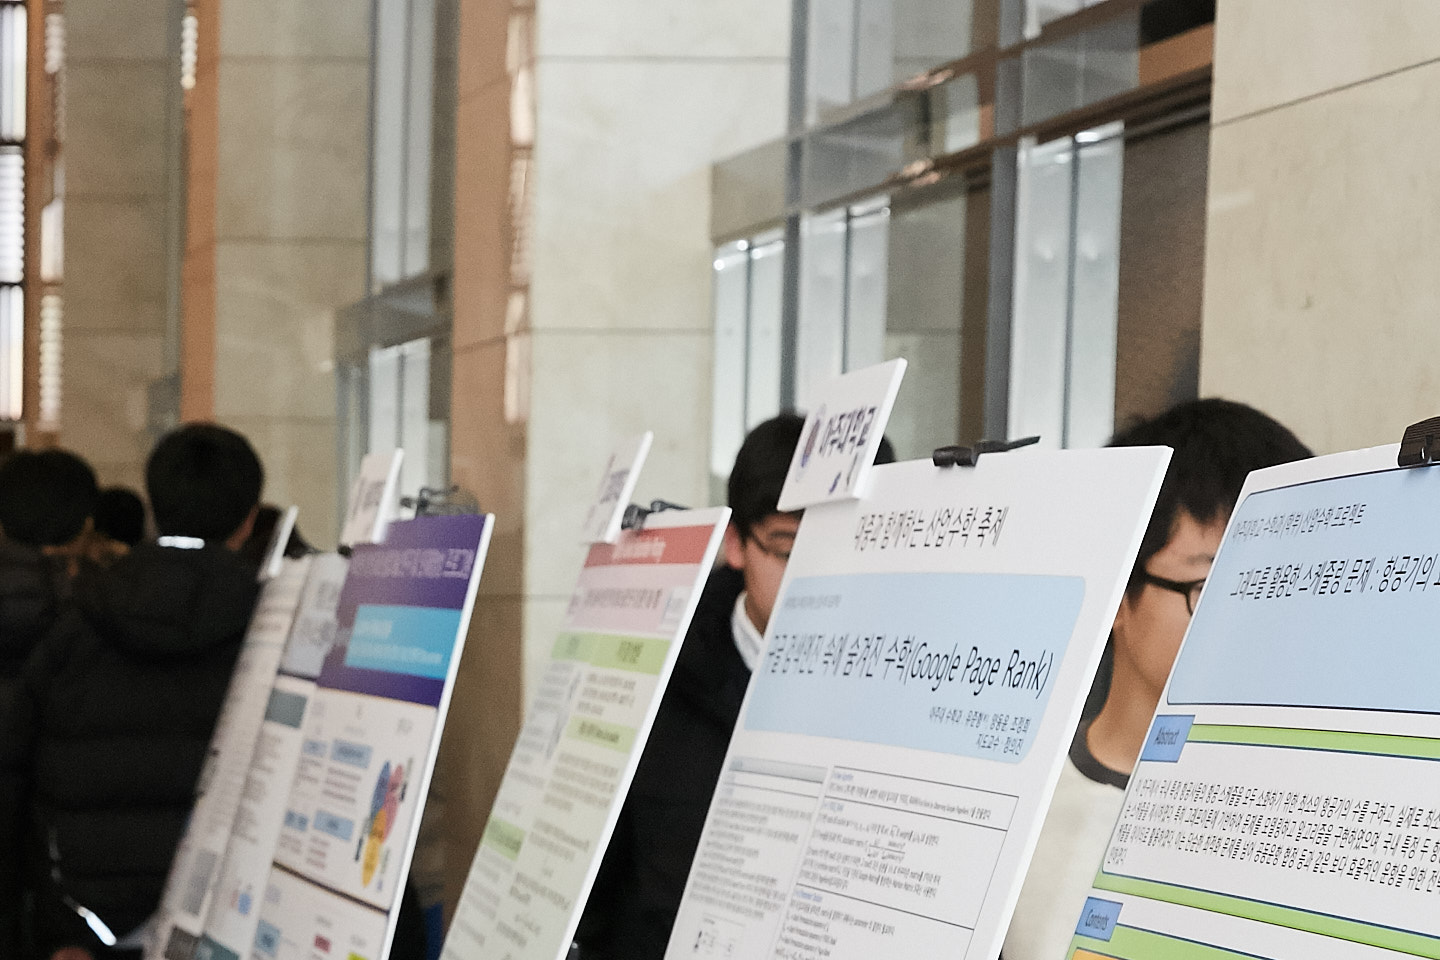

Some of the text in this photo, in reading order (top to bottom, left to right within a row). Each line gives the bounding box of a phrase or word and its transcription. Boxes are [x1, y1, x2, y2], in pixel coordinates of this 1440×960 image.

[1229, 550, 1438, 600] 그래프를 활용한 스케줄링 문제 항공기의
[960, 645, 1001, 696] Page
[1001, 648, 1054, 699] Rank)
